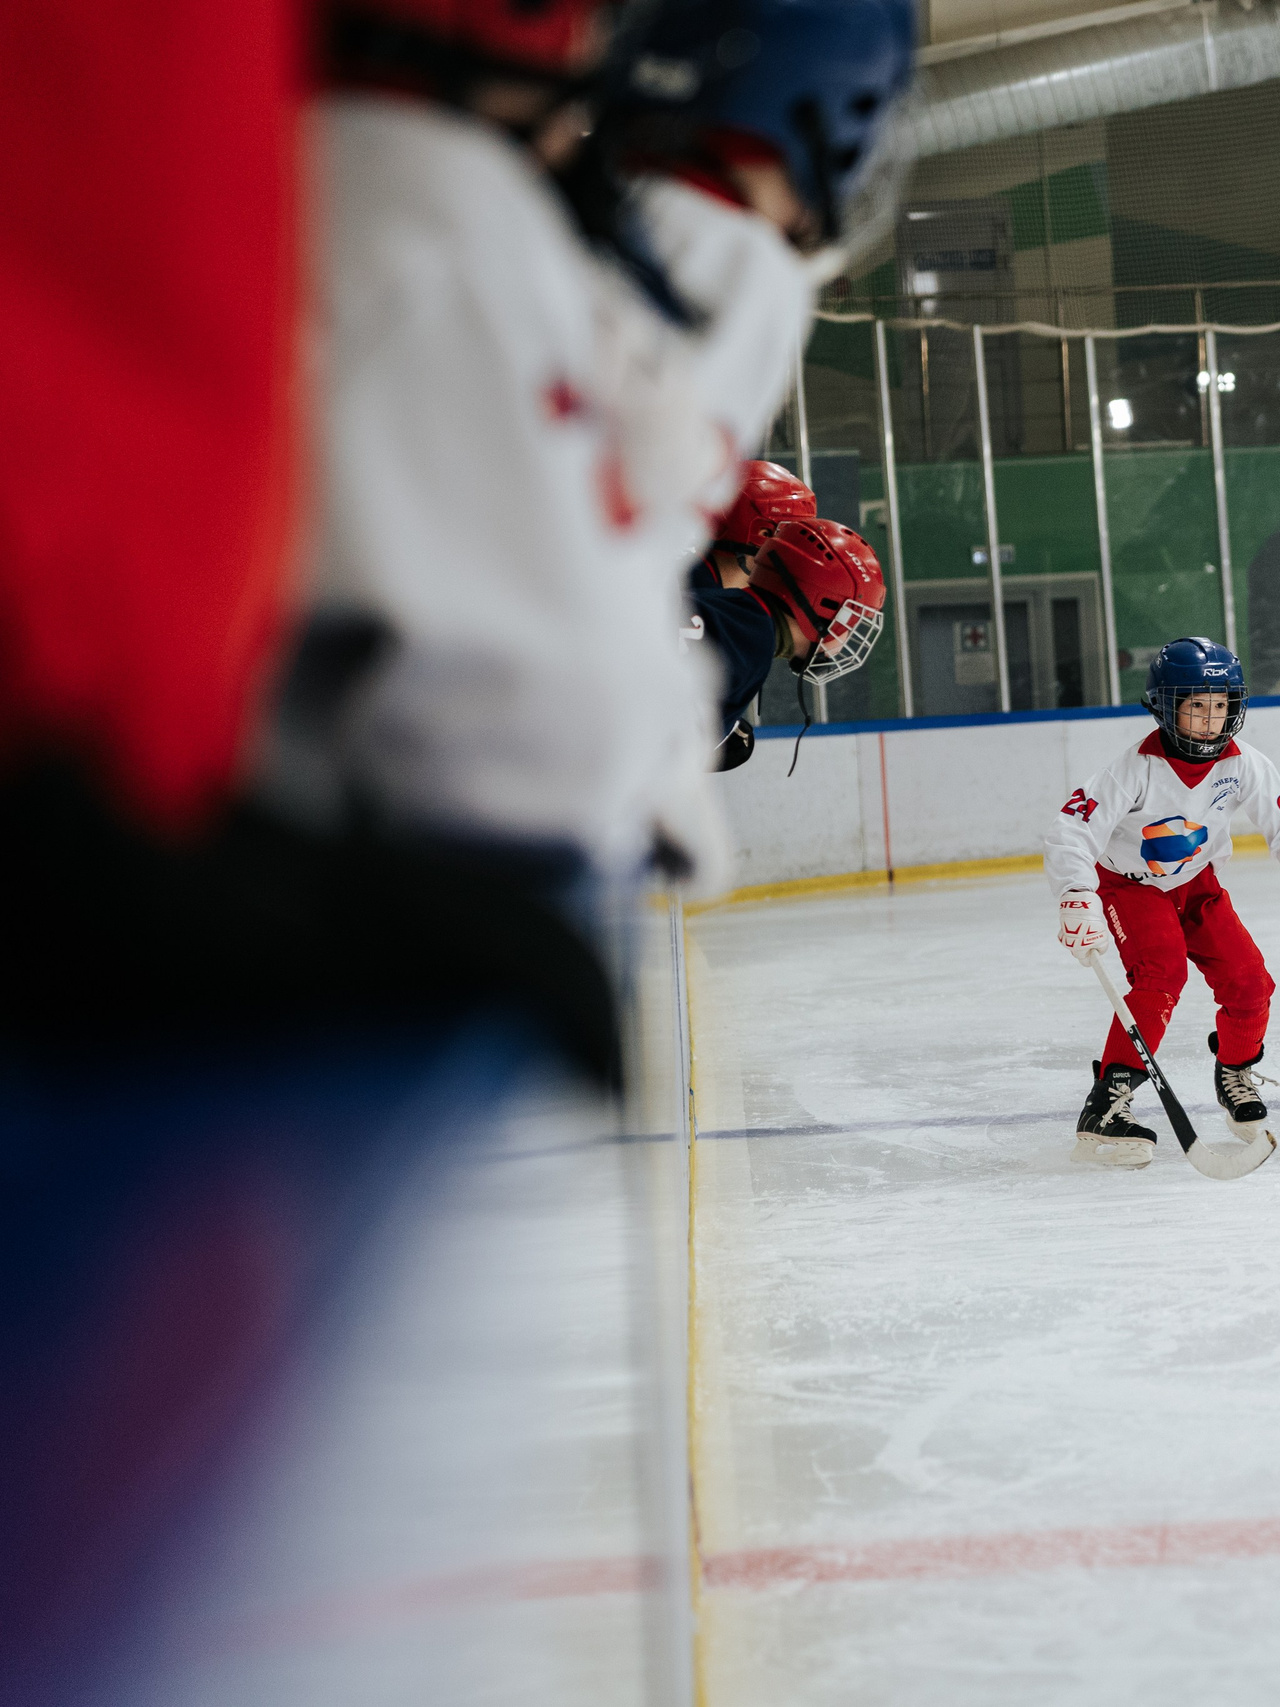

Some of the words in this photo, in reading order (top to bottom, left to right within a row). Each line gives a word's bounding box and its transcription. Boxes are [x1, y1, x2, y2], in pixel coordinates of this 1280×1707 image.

[845, 550, 871, 582] JOFA
[1060, 787, 1099, 823] 24
[1132, 1038, 1166, 1092] STEX
